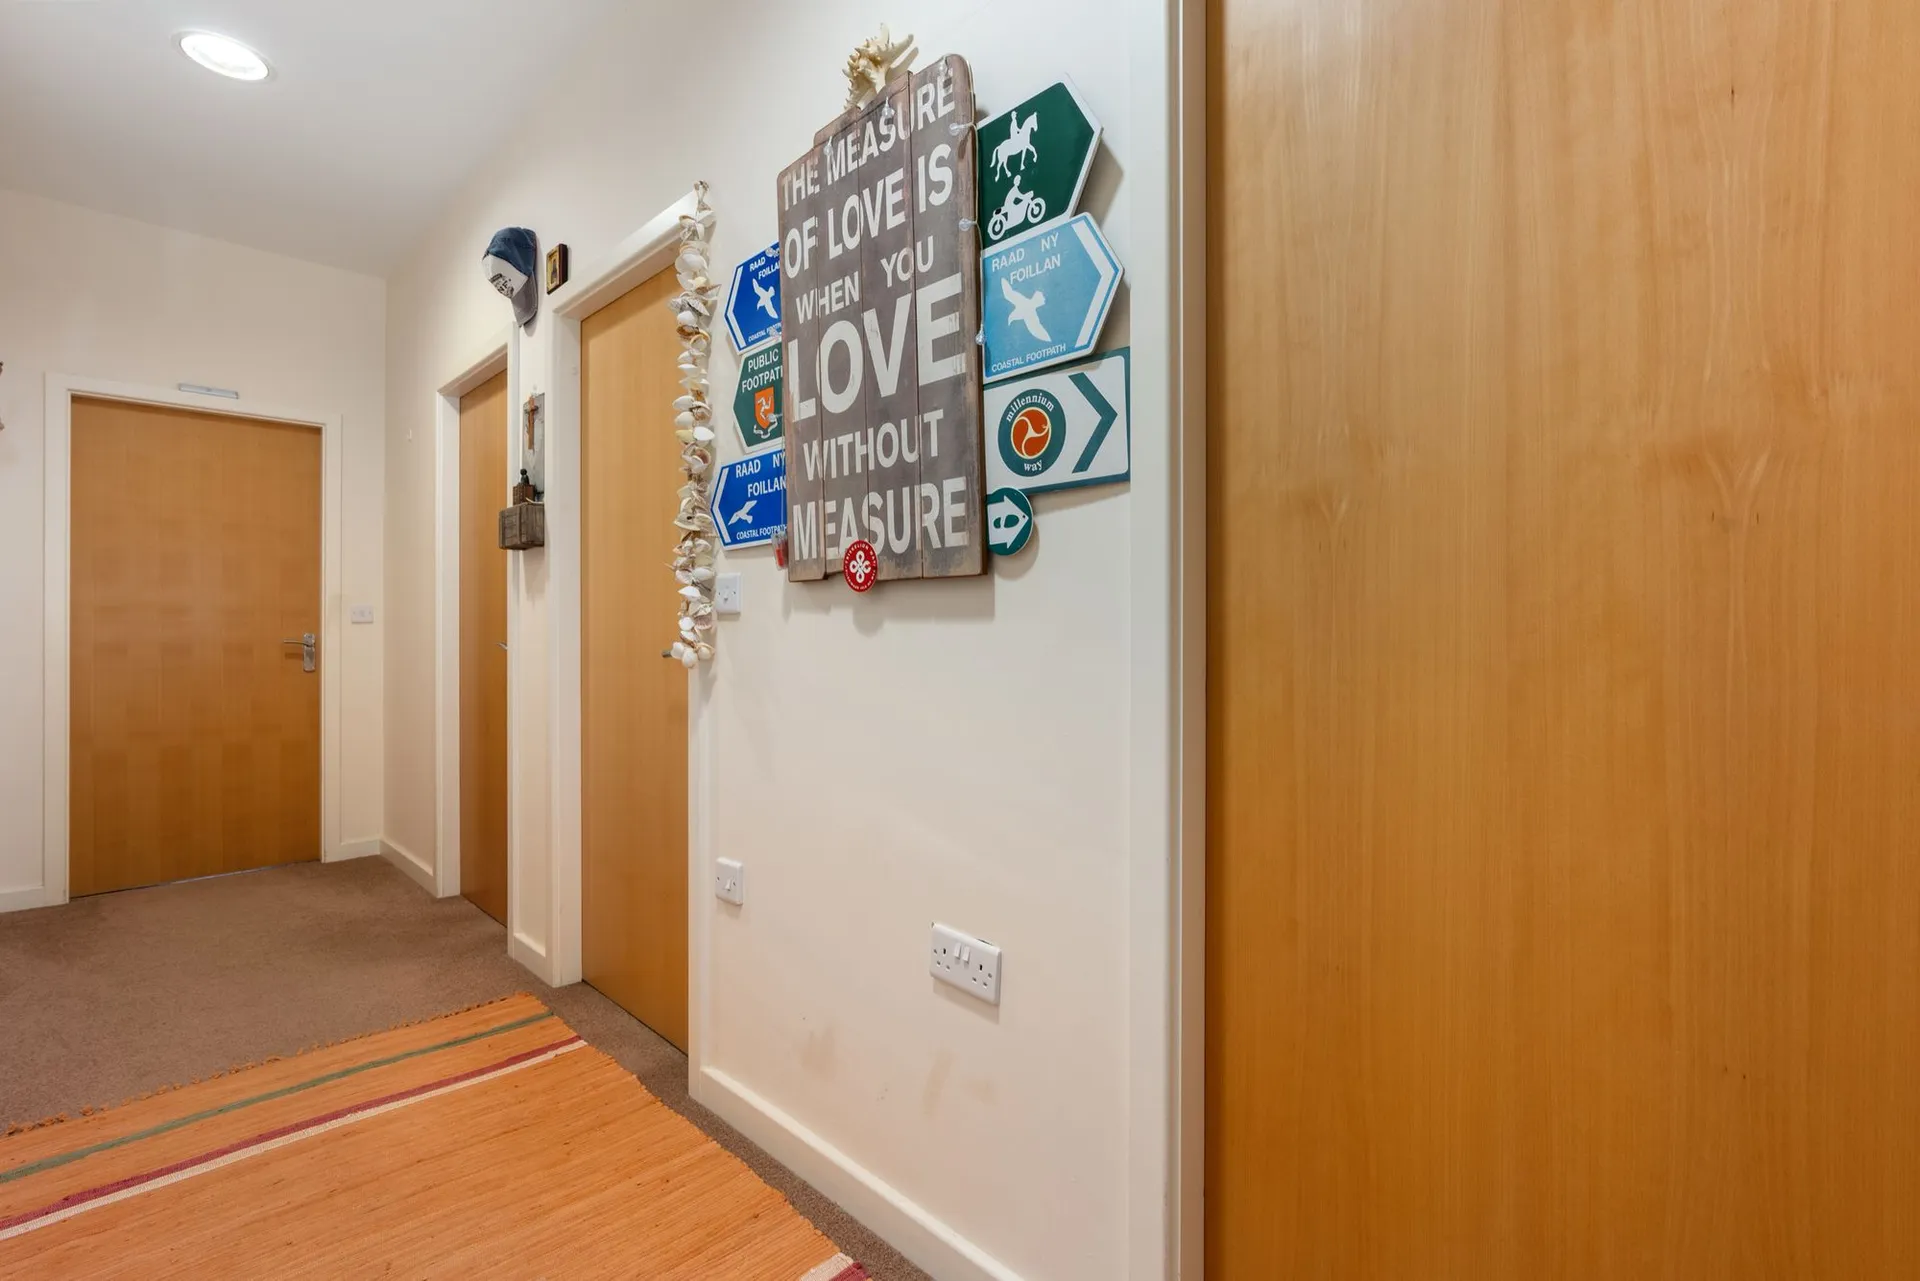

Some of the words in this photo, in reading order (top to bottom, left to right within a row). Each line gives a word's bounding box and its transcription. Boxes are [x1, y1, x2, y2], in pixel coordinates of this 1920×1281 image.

[782, 156, 820, 211] THE
[826, 68, 955, 185] MEASURE
[784, 215, 818, 279] OF
[827, 168, 906, 260] LOVE
[917, 144, 953, 213] IS
[749, 256, 766, 272] RAAD
[991, 248, 1025, 273] RAAD
[1041, 232, 1059, 252] NY
[795, 271, 860, 324] WHEN
[880, 236, 934, 288] YOU
[1010, 254, 1061, 285] FOILLAN
[747, 348, 779, 373] PUBLIC
[787, 272, 967, 422] LOVE
[991, 357, 1024, 372] COASTAL
[1026, 343, 1066, 361] FOOTPATH
[1006, 392, 1055, 422] millennium
[803, 409, 944, 481] WITHOUT
[735, 459, 760, 478] RAAD
[772, 450, 786, 468] NY
[1023, 459, 1043, 471] way
[747, 475, 786, 498] FOILLAN
[792, 476, 970, 561] MEASURE
[736, 529, 759, 540] COASTAL
